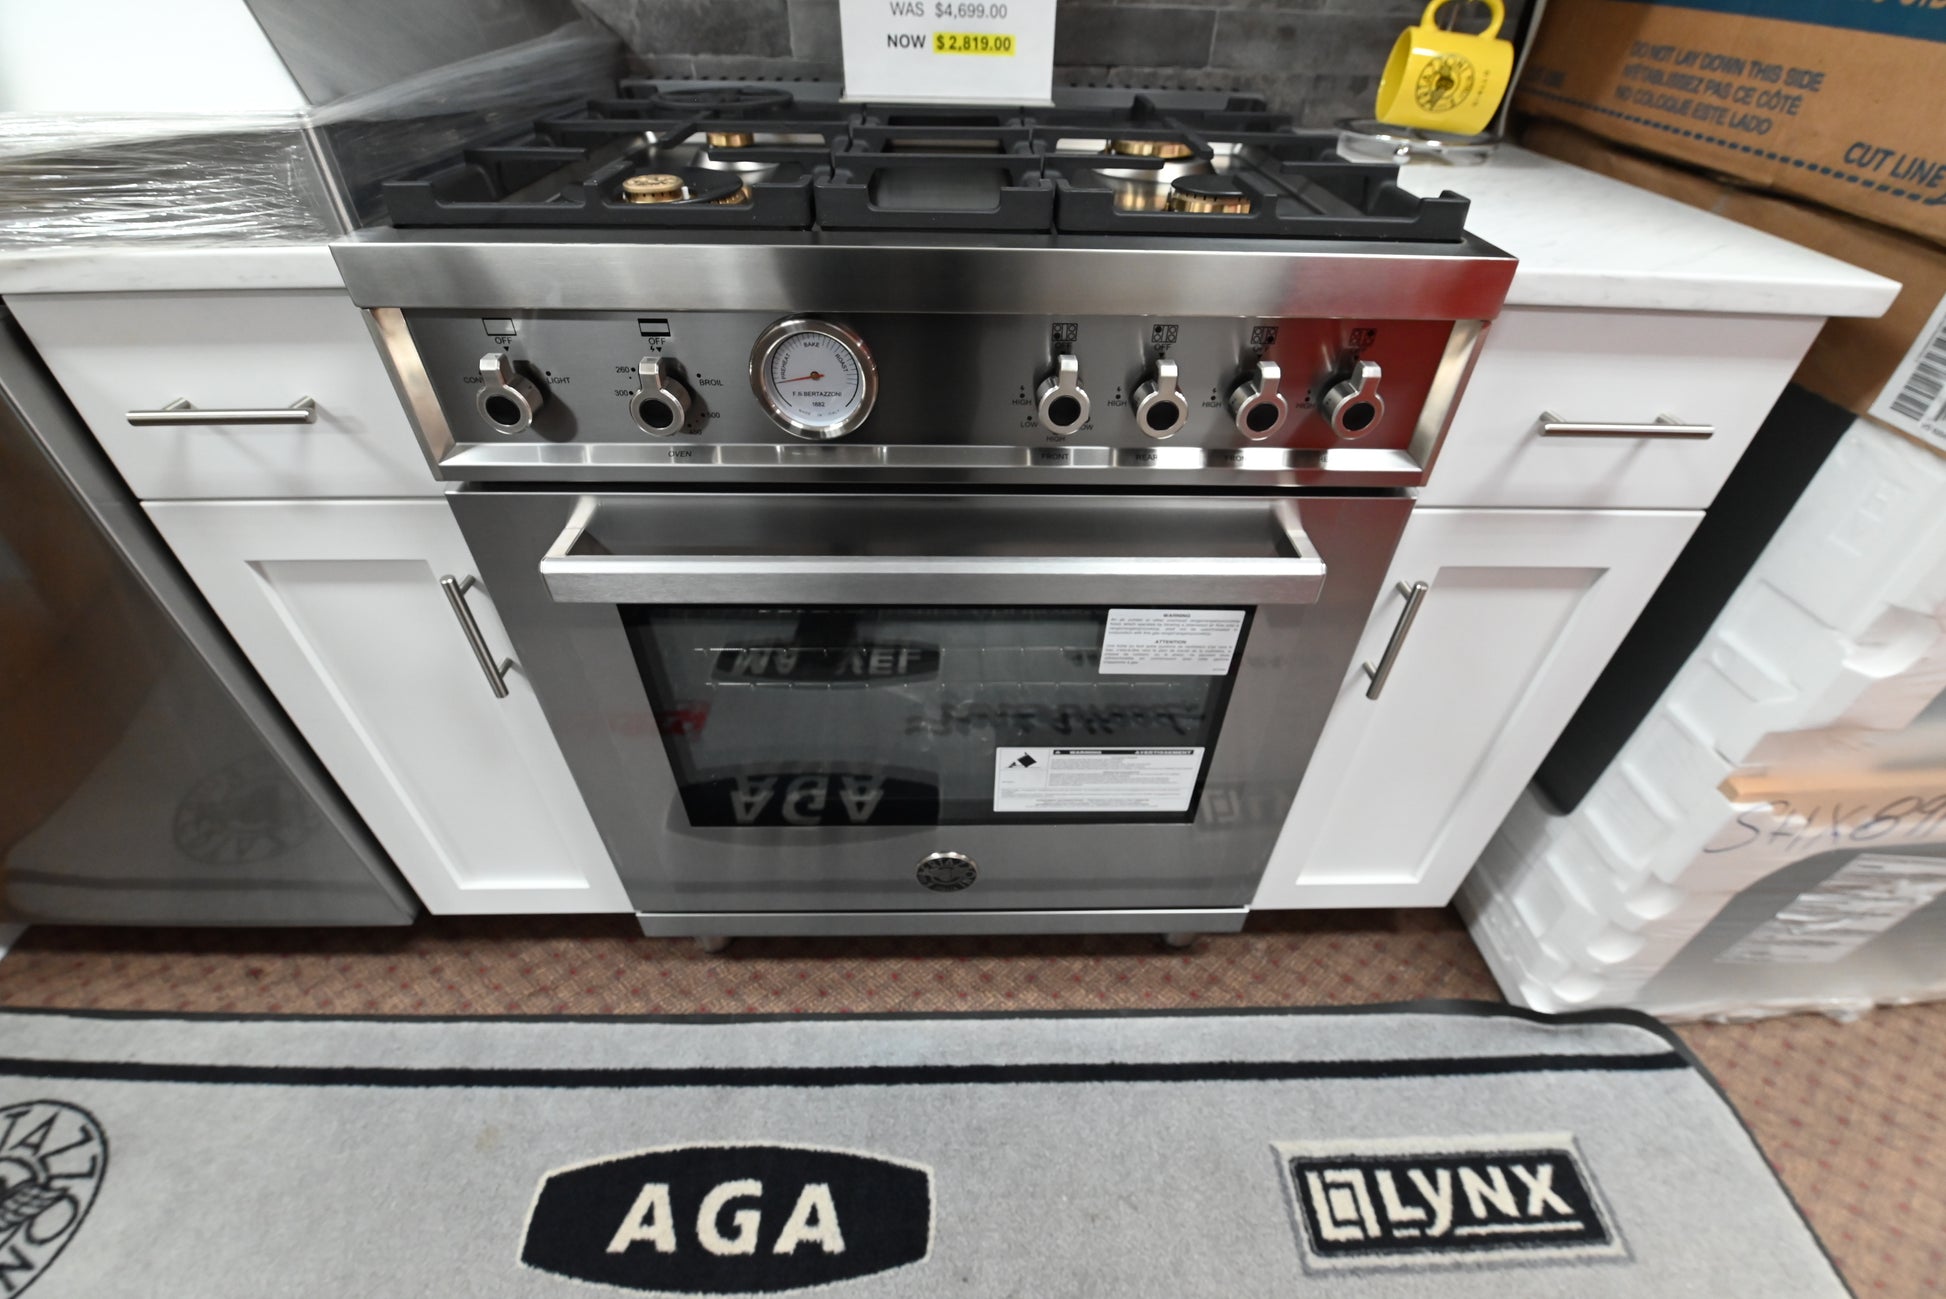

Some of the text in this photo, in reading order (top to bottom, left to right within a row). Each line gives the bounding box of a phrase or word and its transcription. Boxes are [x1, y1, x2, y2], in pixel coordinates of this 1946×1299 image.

[890, 1, 1008, 19] WAS $4,699.00
[887, 34, 926, 49] NOW
[1675, 49, 1700, 67] LAY
[1700, 53, 1746, 76] DOWN
[1749, 61, 1783, 83] THIS
[1785, 67, 1825, 92] SIDE
[1704, 79, 1733, 99] PAS
[1733, 86, 1757, 105] CE
[1692, 102, 1730, 126] ESTE
[1728, 111, 1773, 135] LADO
[1843, 141, 1946, 189] CUT LINE
[648, 337, 666, 345] OFF
[1154, 343, 1171, 351] OFF
[614, 389, 628, 397] 300
[605, 1178, 846, 1257] AGA
